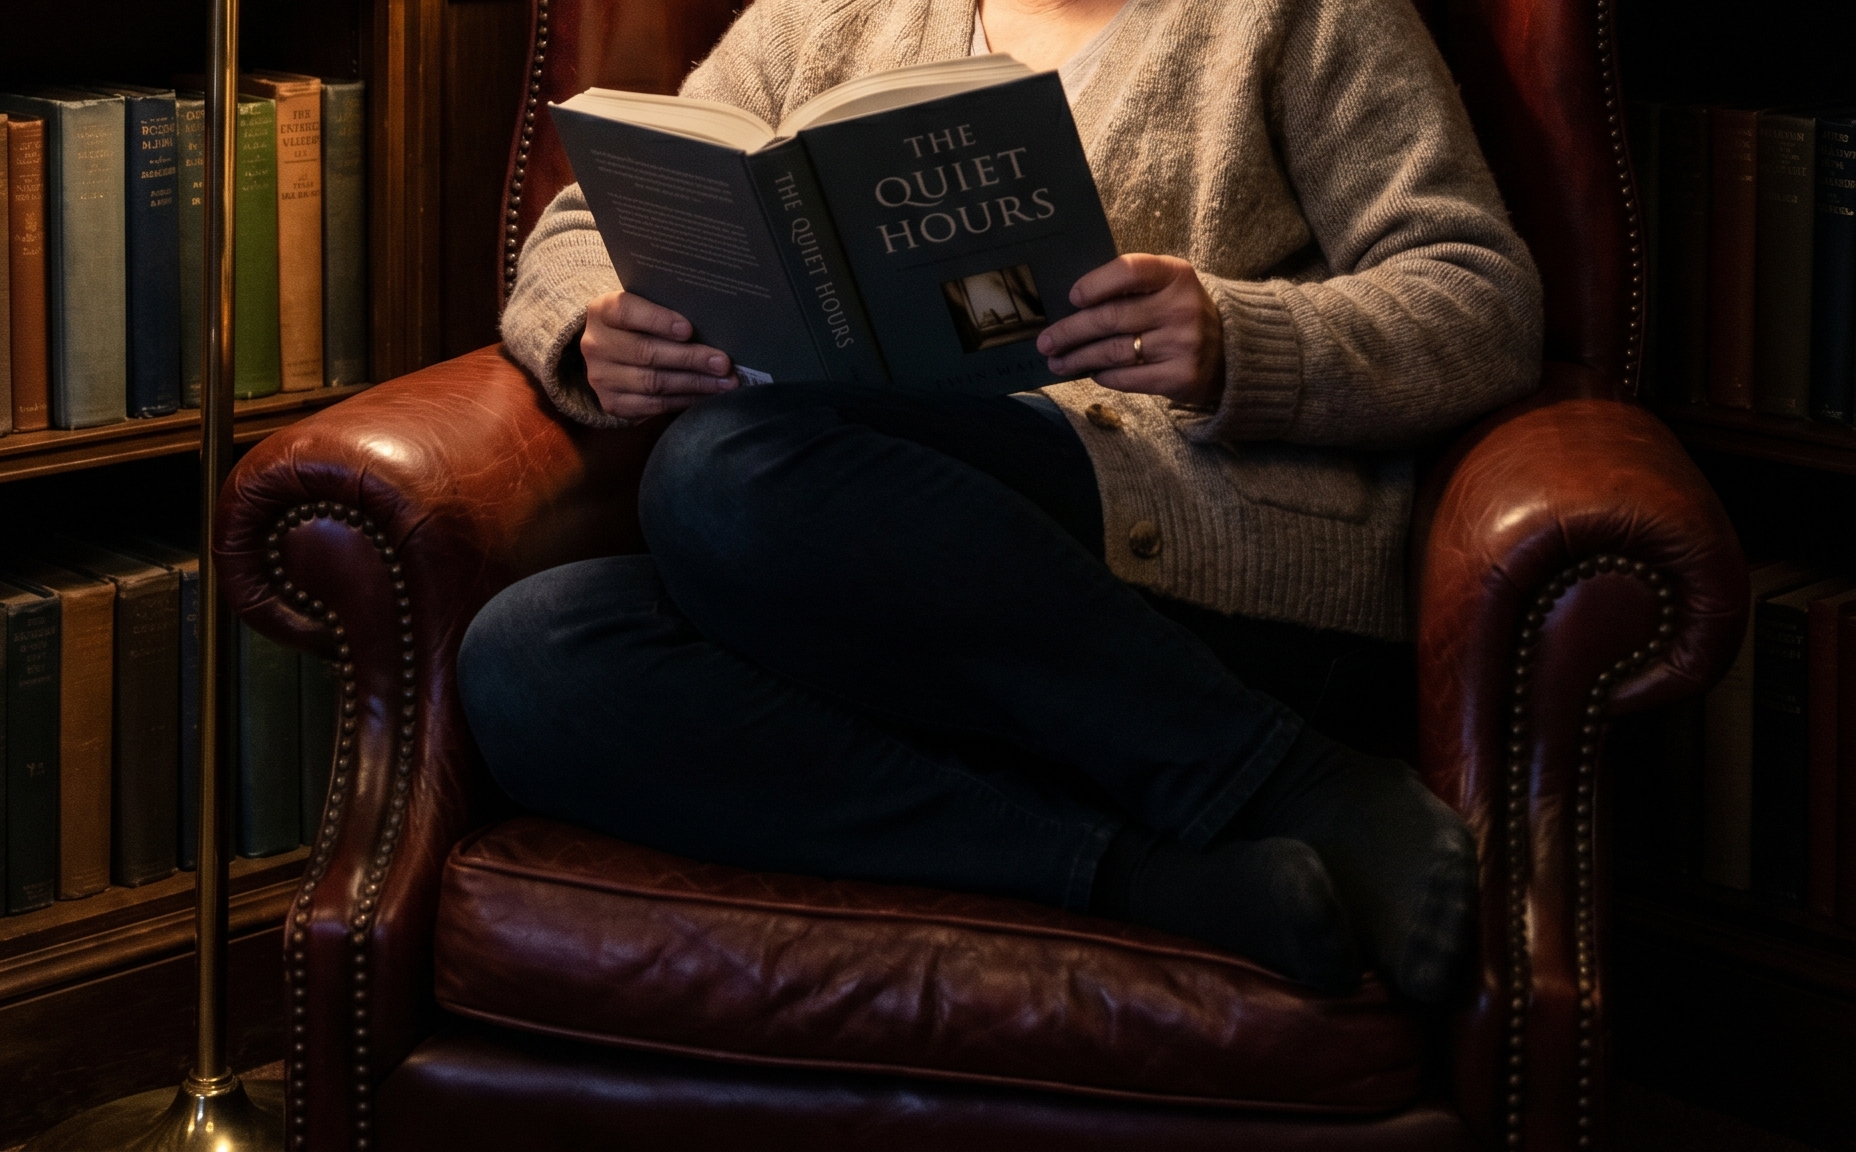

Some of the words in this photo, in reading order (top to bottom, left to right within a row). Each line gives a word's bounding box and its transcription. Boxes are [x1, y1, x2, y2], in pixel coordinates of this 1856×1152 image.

[903, 123, 977, 159] THE
[874, 146, 1027, 208] QUIET
[875, 187, 1056, 255] HOURS
[774, 171, 803, 212] THE
[791, 217, 828, 276] QUIET
[815, 281, 854, 349] HOURS
